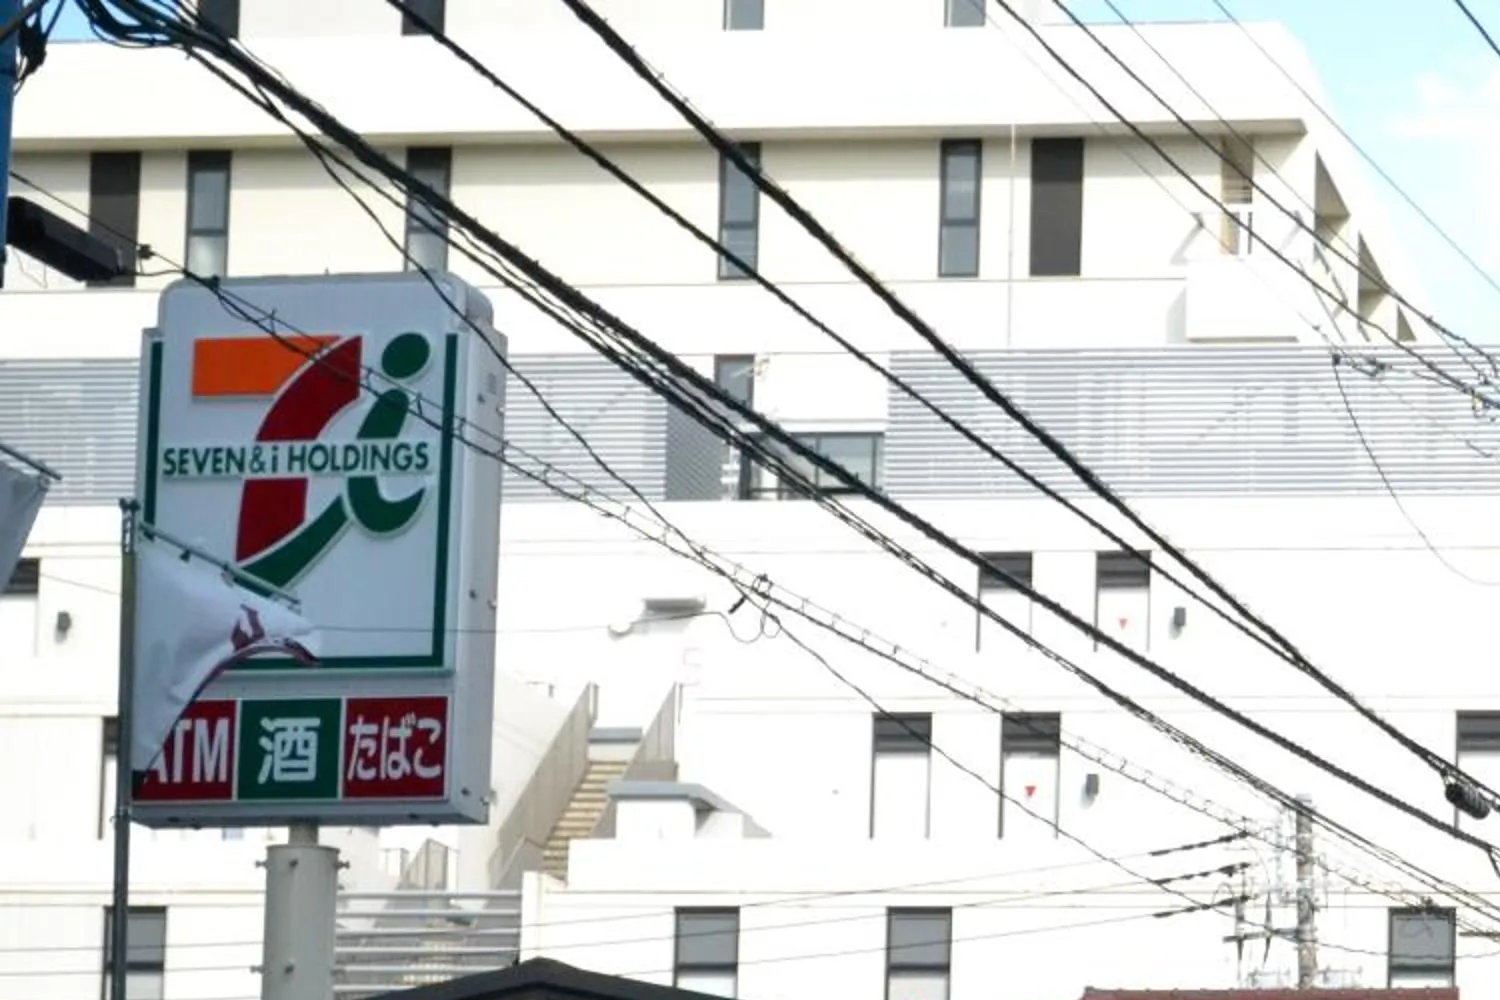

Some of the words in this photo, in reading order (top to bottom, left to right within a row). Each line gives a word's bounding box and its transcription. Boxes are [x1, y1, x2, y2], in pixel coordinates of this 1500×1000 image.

[287, 442, 430, 473] HOLDINGS
[258, 717, 321, 784] 酒
[348, 712, 442, 781] たばこ
